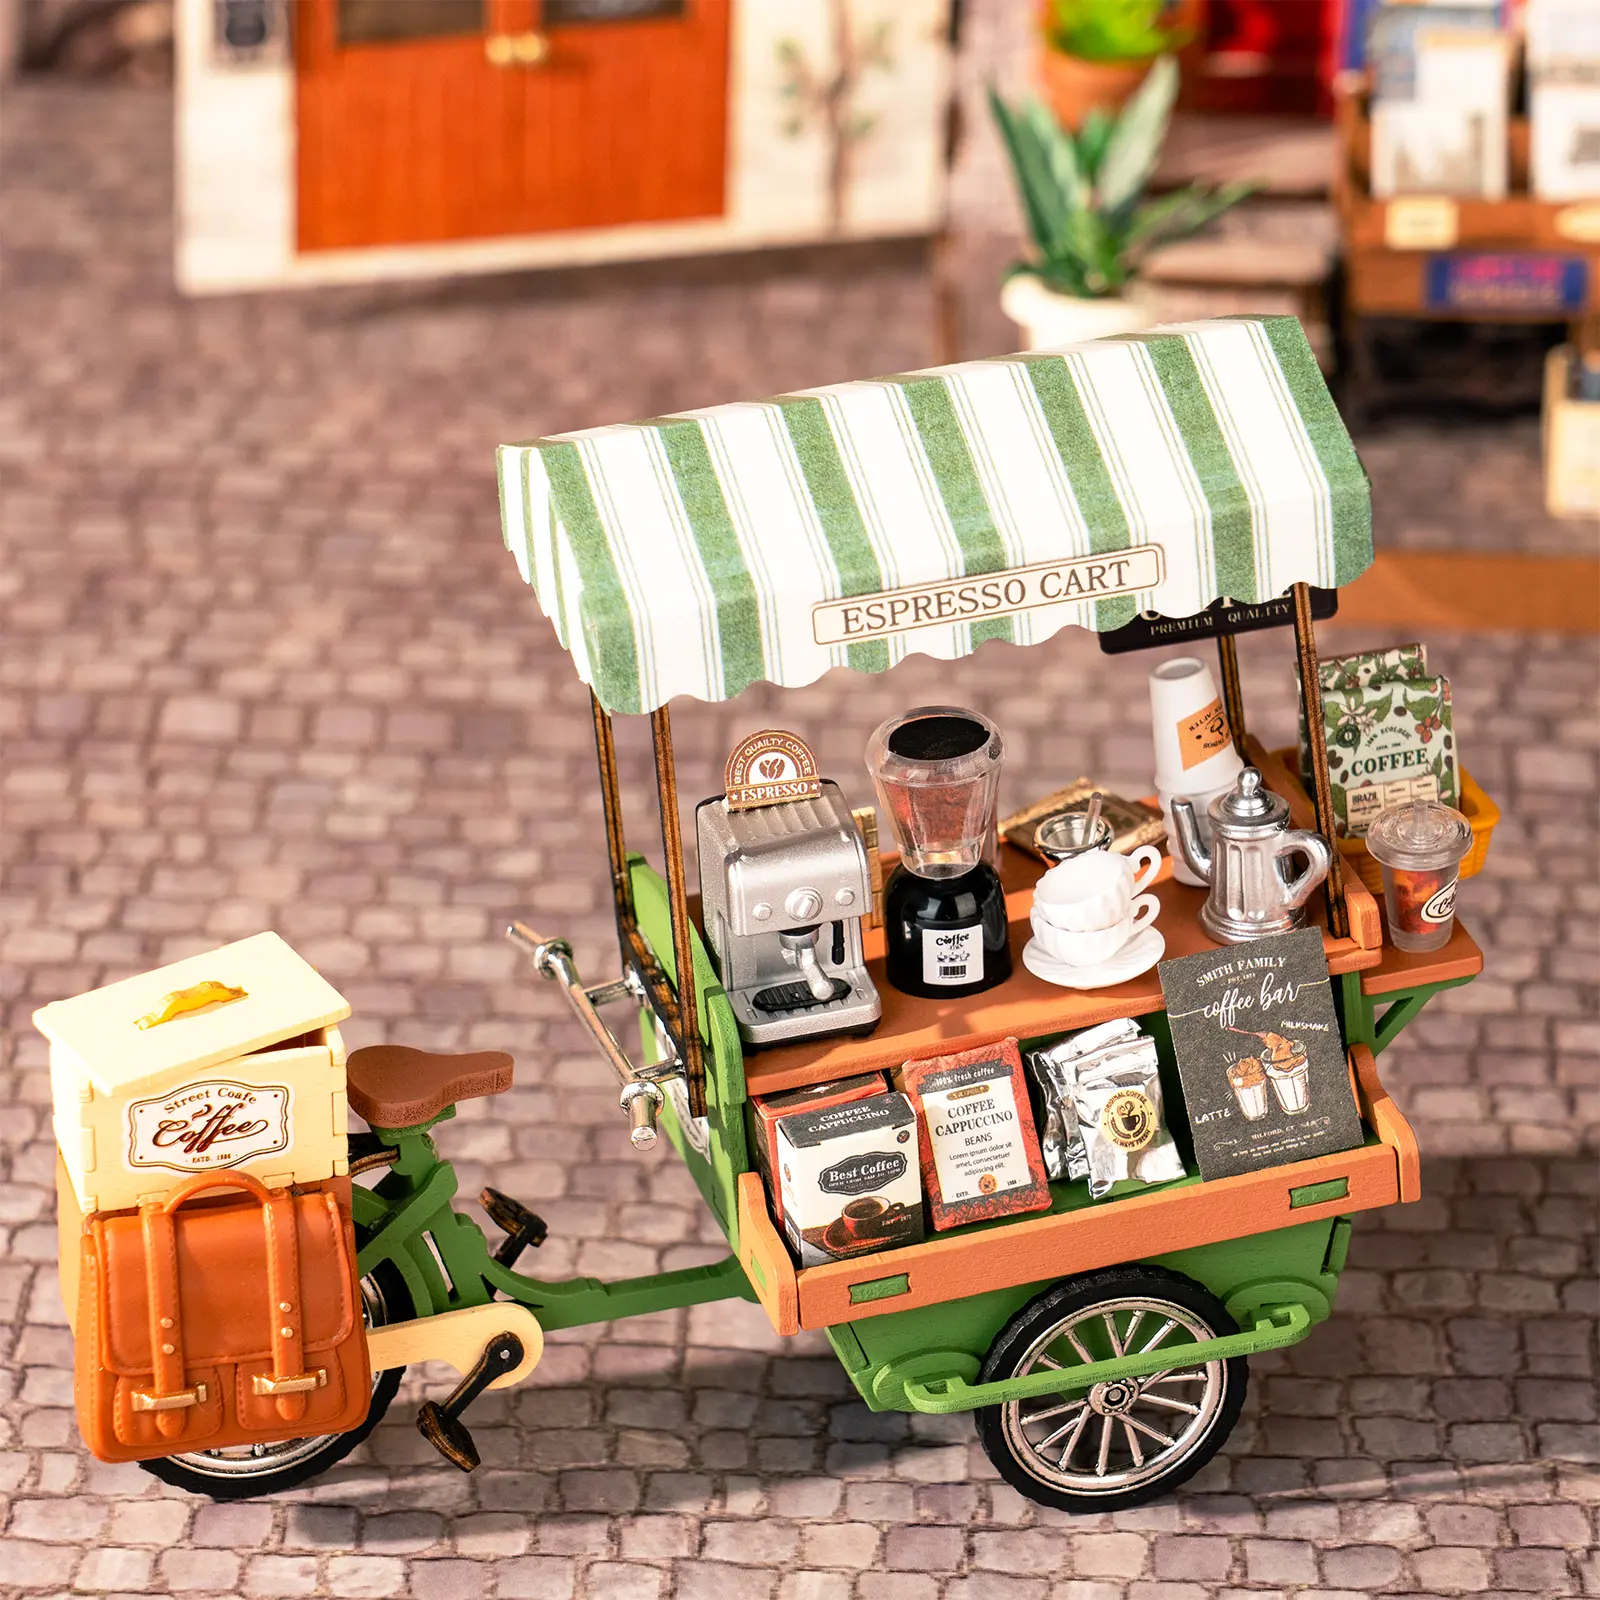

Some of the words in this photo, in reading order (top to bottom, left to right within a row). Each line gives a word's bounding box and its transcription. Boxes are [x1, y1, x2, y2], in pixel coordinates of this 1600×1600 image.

[841, 579, 1026, 635] ESPRESSO
[1040, 560, 1131, 599] CART
[1151, 615, 1214, 636] PREMIUM
[1227, 603, 1291, 623] QUALITY
[734, 756, 746, 784] BEST
[785, 741, 812, 774] COFFEE
[1351, 748, 1427, 777] COFFEE
[740, 782, 808, 802] ESPRESSO
[936, 933, 970, 946] Coffee
[1196, 963, 1233, 987] SMITH
[1237, 957, 1286, 970] FAMILY
[1204, 988, 1254, 1028] coffee
[1260, 972, 1300, 1011] bar
[1281, 1020, 1329, 1032] MILKSHAKE
[935, 1077, 953, 1086] 100%
[954, 1071, 972, 1081] fresh
[973, 1067, 995, 1078] coffee
[164, 1089, 210, 1114] Street
[217, 1087, 257, 1104] Coafe
[1126, 1091, 1147, 1103] COFFEE
[820, 1105, 872, 1123] COFFEE
[947, 1098, 995, 1119] COFFEE
[1194, 1108, 1231, 1124] LATTE
[152, 1102, 269, 1154] Coffee
[808, 1109, 890, 1133] CAPPUCCINO
[935, 1110, 1013, 1137] CAPPUCCINO
[964, 1132, 993, 1147] BEANS
[969, 1148, 988, 1157] ipsum
[988, 1144, 1004, 1152] dolor
[829, 1167, 858, 1182] Best
[860, 1159, 900, 1176] Coffee
[955, 1161, 972, 1169] amet,
[964, 1165, 994, 1176] adipiscing
